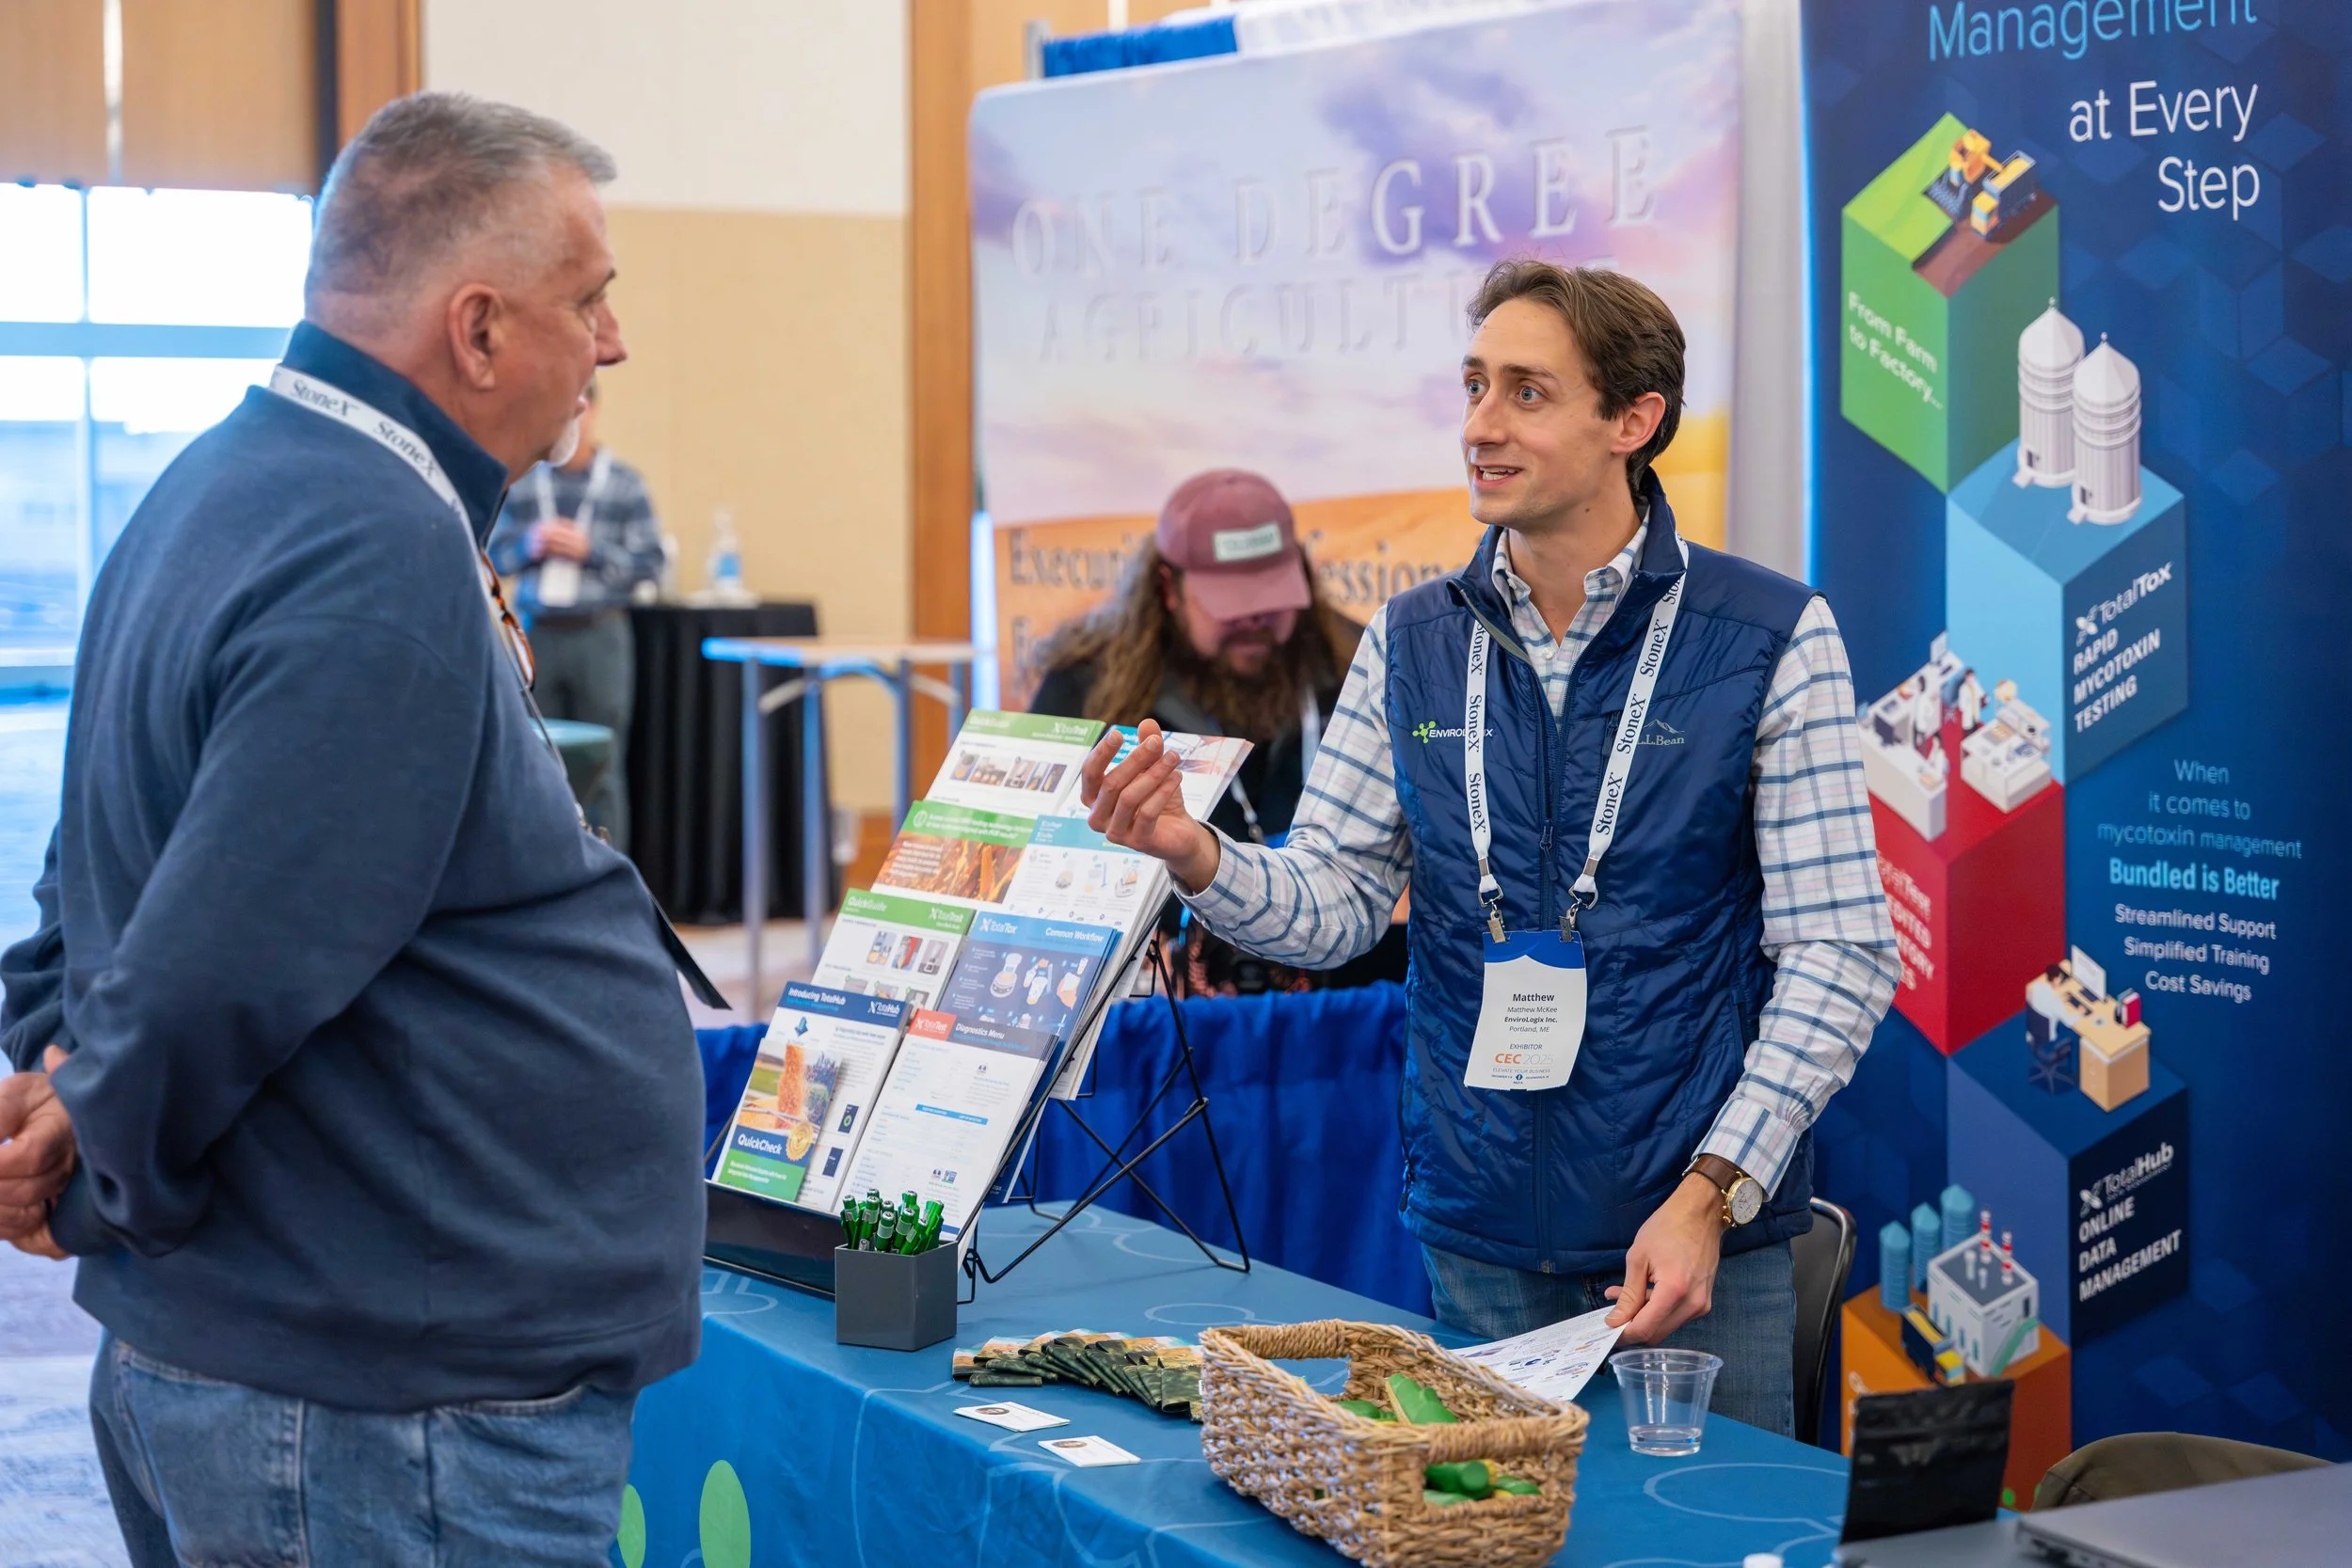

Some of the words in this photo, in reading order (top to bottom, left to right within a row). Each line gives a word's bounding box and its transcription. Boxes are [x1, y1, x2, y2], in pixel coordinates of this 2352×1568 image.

[2070, 89, 2112, 142] at
[2130, 81, 2258, 142] Every
[1011, 184, 1177, 282] ONE
[1232, 124, 1657, 267] DEGREE
[2159, 156, 2260, 221] Step
[1849, 291, 1892, 340] From
[1896, 326, 1938, 373] Farm
[1850, 324, 1867, 351] to
[2098, 562, 2174, 625] TotalTox
[1640, 618, 1669, 677] StoneX
[2074, 627, 2119, 675] RAPID
[2074, 627, 2161, 705] MYCOTOXIN
[1469, 694, 1483, 752] StoneX
[1617, 693, 1646, 754] StoneX
[2074, 674, 2138, 734] TESTING
[2174, 759, 2230, 784] When
[1469, 772, 1486, 832] StoneX
[1596, 771, 1624, 835] StoneX
[2148, 791, 2161, 814] it
[2166, 795, 2231, 817] comes
[2234, 798, 2251, 820] to
[2097, 823, 2195, 847] mycotoxin
[2201, 831, 2303, 859] management
[2109, 857, 2197, 891] Bundled
[2201, 863, 2220, 894] is
[2223, 866, 2280, 900] Better
[1045, 927, 1074, 940] Common
[1074, 931, 1104, 943] Workflow
[2115, 903, 2216, 931] Streamlined
[2218, 912, 2277, 940] Support
[2123, 936, 2208, 962] Simplified
[2211, 943, 2270, 975] Training
[788, 988, 820, 1003] Introducing
[1513, 993, 1554, 1002] Matthew
[2145, 970, 2186, 993] Cost
[2189, 974, 2252, 1004] Savings
[955, 1022, 988, 1037] Diagnostics
[988, 1028, 1006, 1039] Menu
[1495, 1053, 1522, 1064] CEC
[1522, 1053, 1554, 1065] 2025
[738, 1132, 783, 1156] QuickCheck
[2104, 1142, 2174, 1196] TotalHub
[2078, 1196, 2136, 1244] ONLINE
[2078, 1236, 2117, 1274] DATA
[2078, 1228, 2183, 1303] MANAGEMENT
